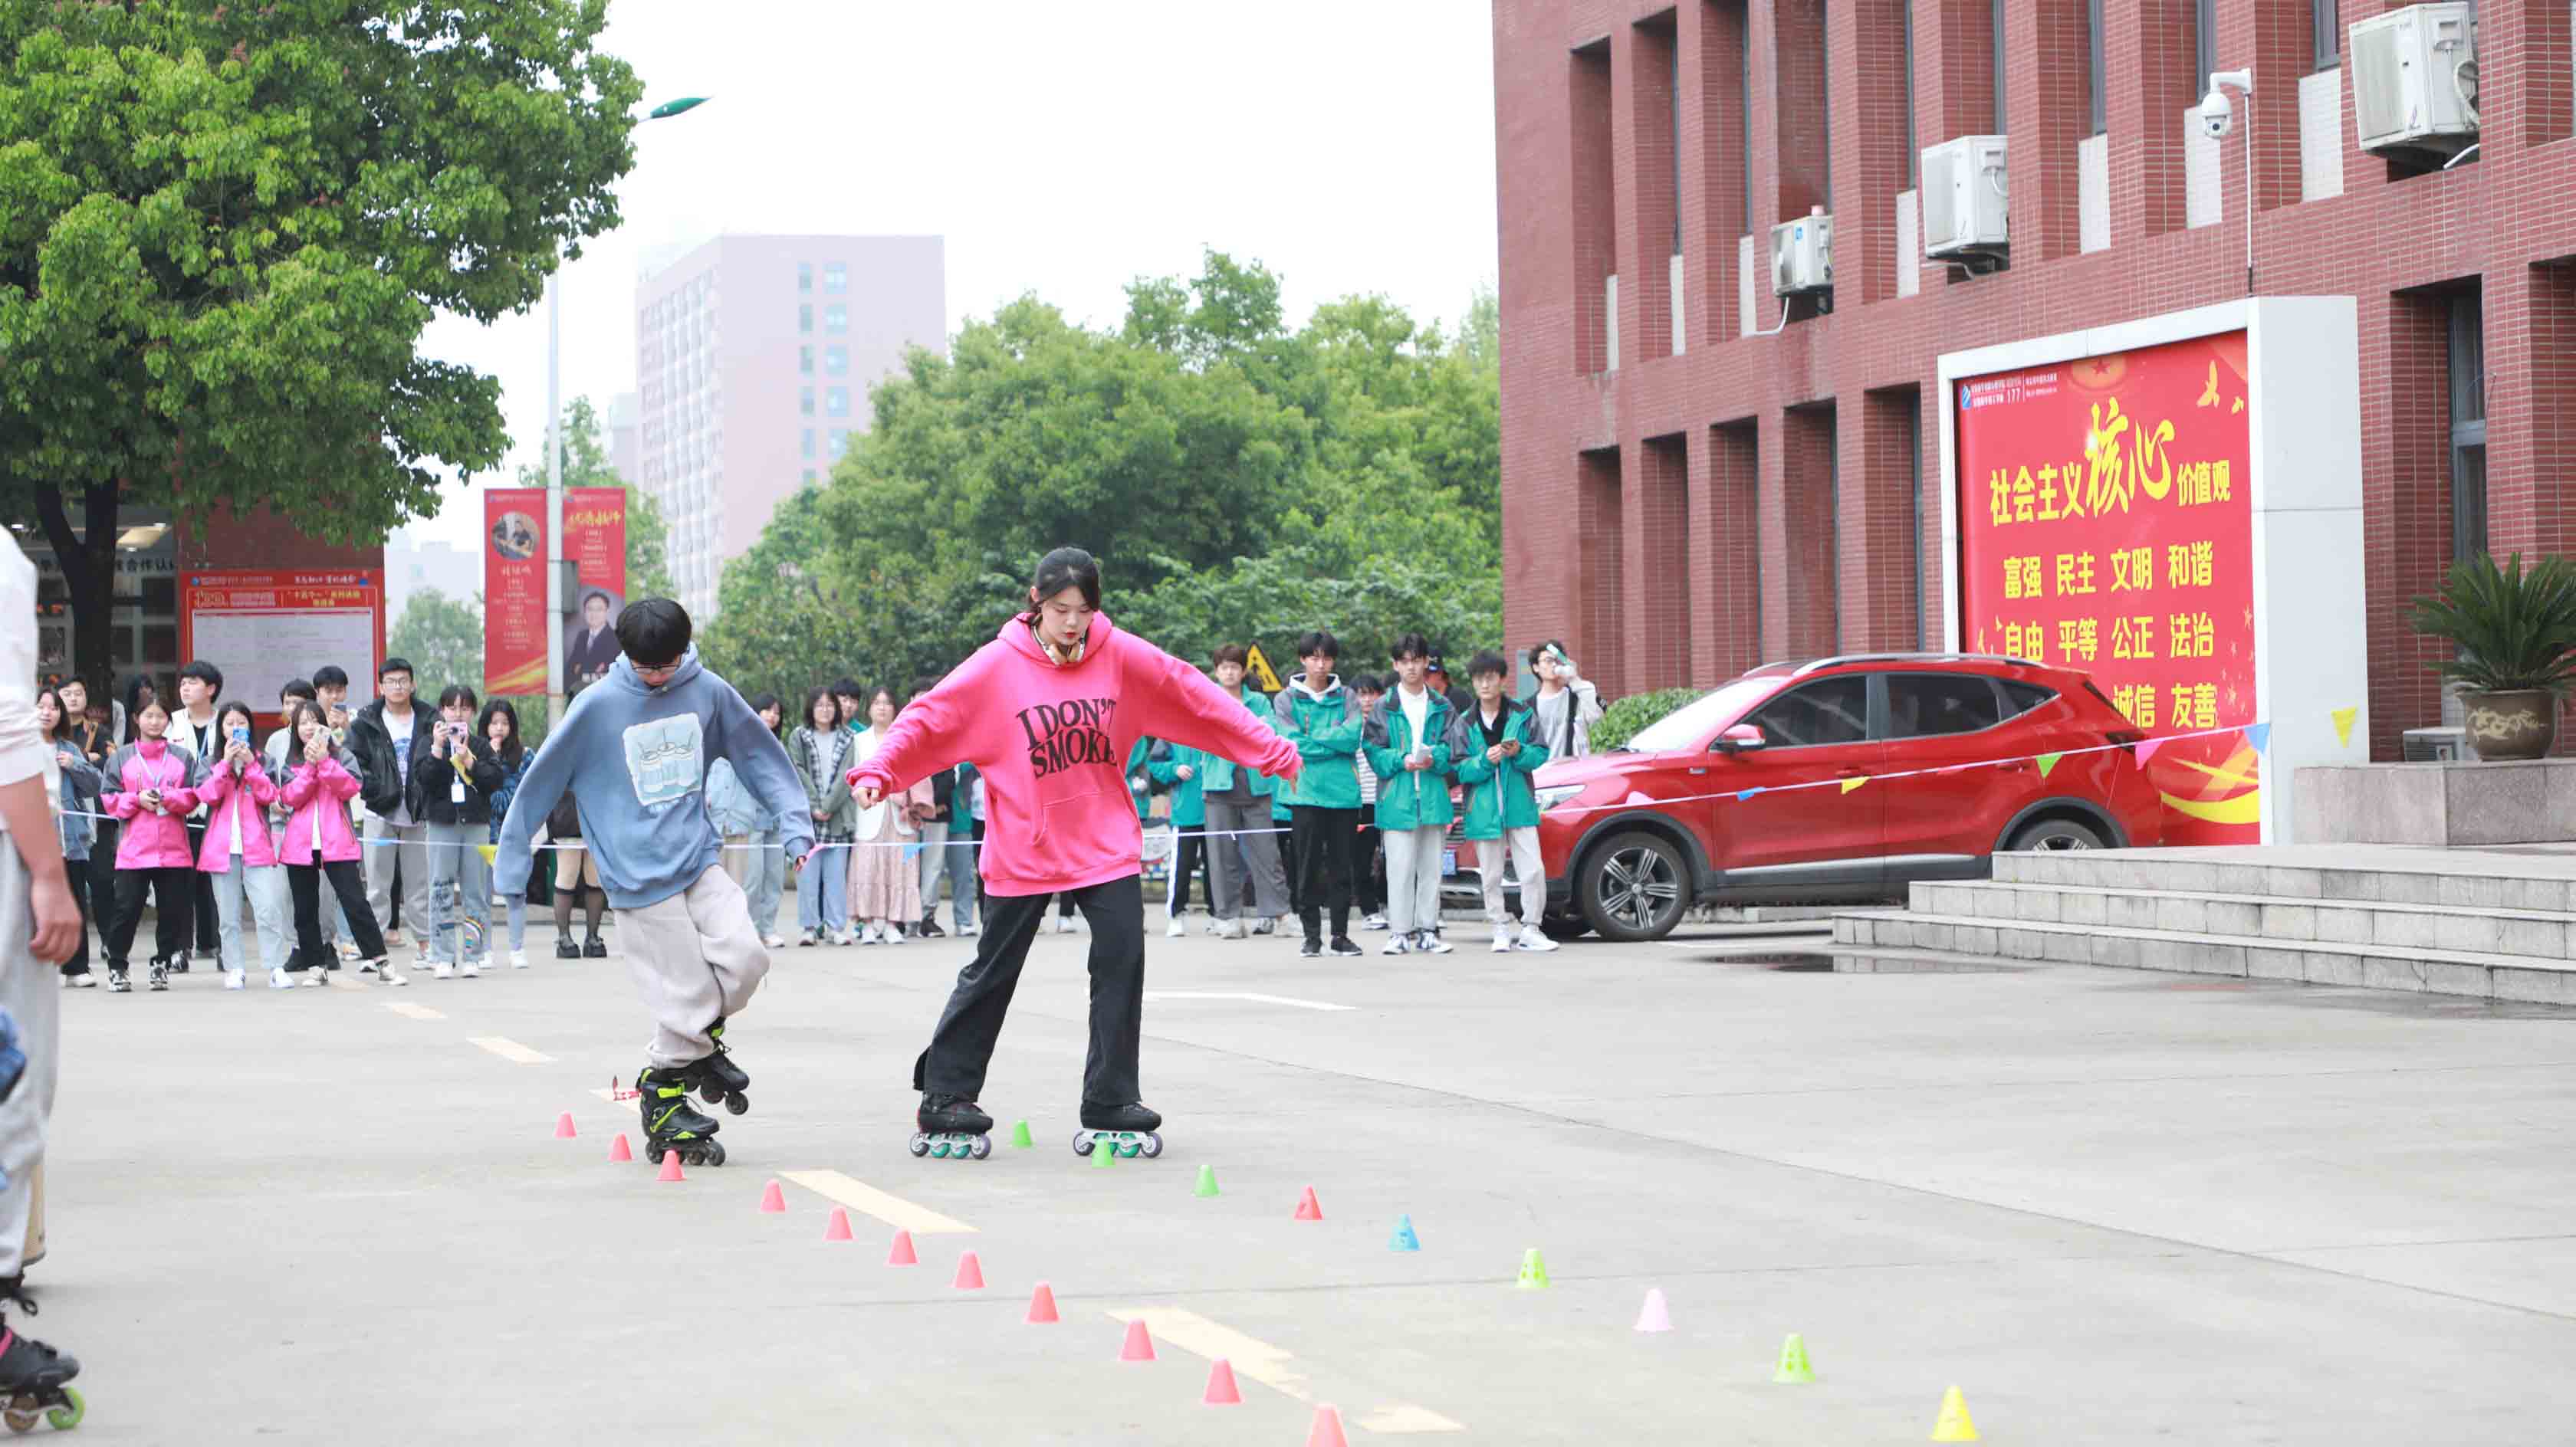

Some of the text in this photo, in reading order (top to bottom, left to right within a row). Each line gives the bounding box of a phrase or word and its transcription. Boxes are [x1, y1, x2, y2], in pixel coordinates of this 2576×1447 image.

[1990, 396, 2231, 527] 社会主义核心价值观
[2003, 540, 2213, 599] 富强 民主 文明 和谐
[2005, 612, 2214, 663] 自由 平等 公正 法治
[1016, 708, 1041, 751] I
[2170, 682, 2217, 728] 友善
